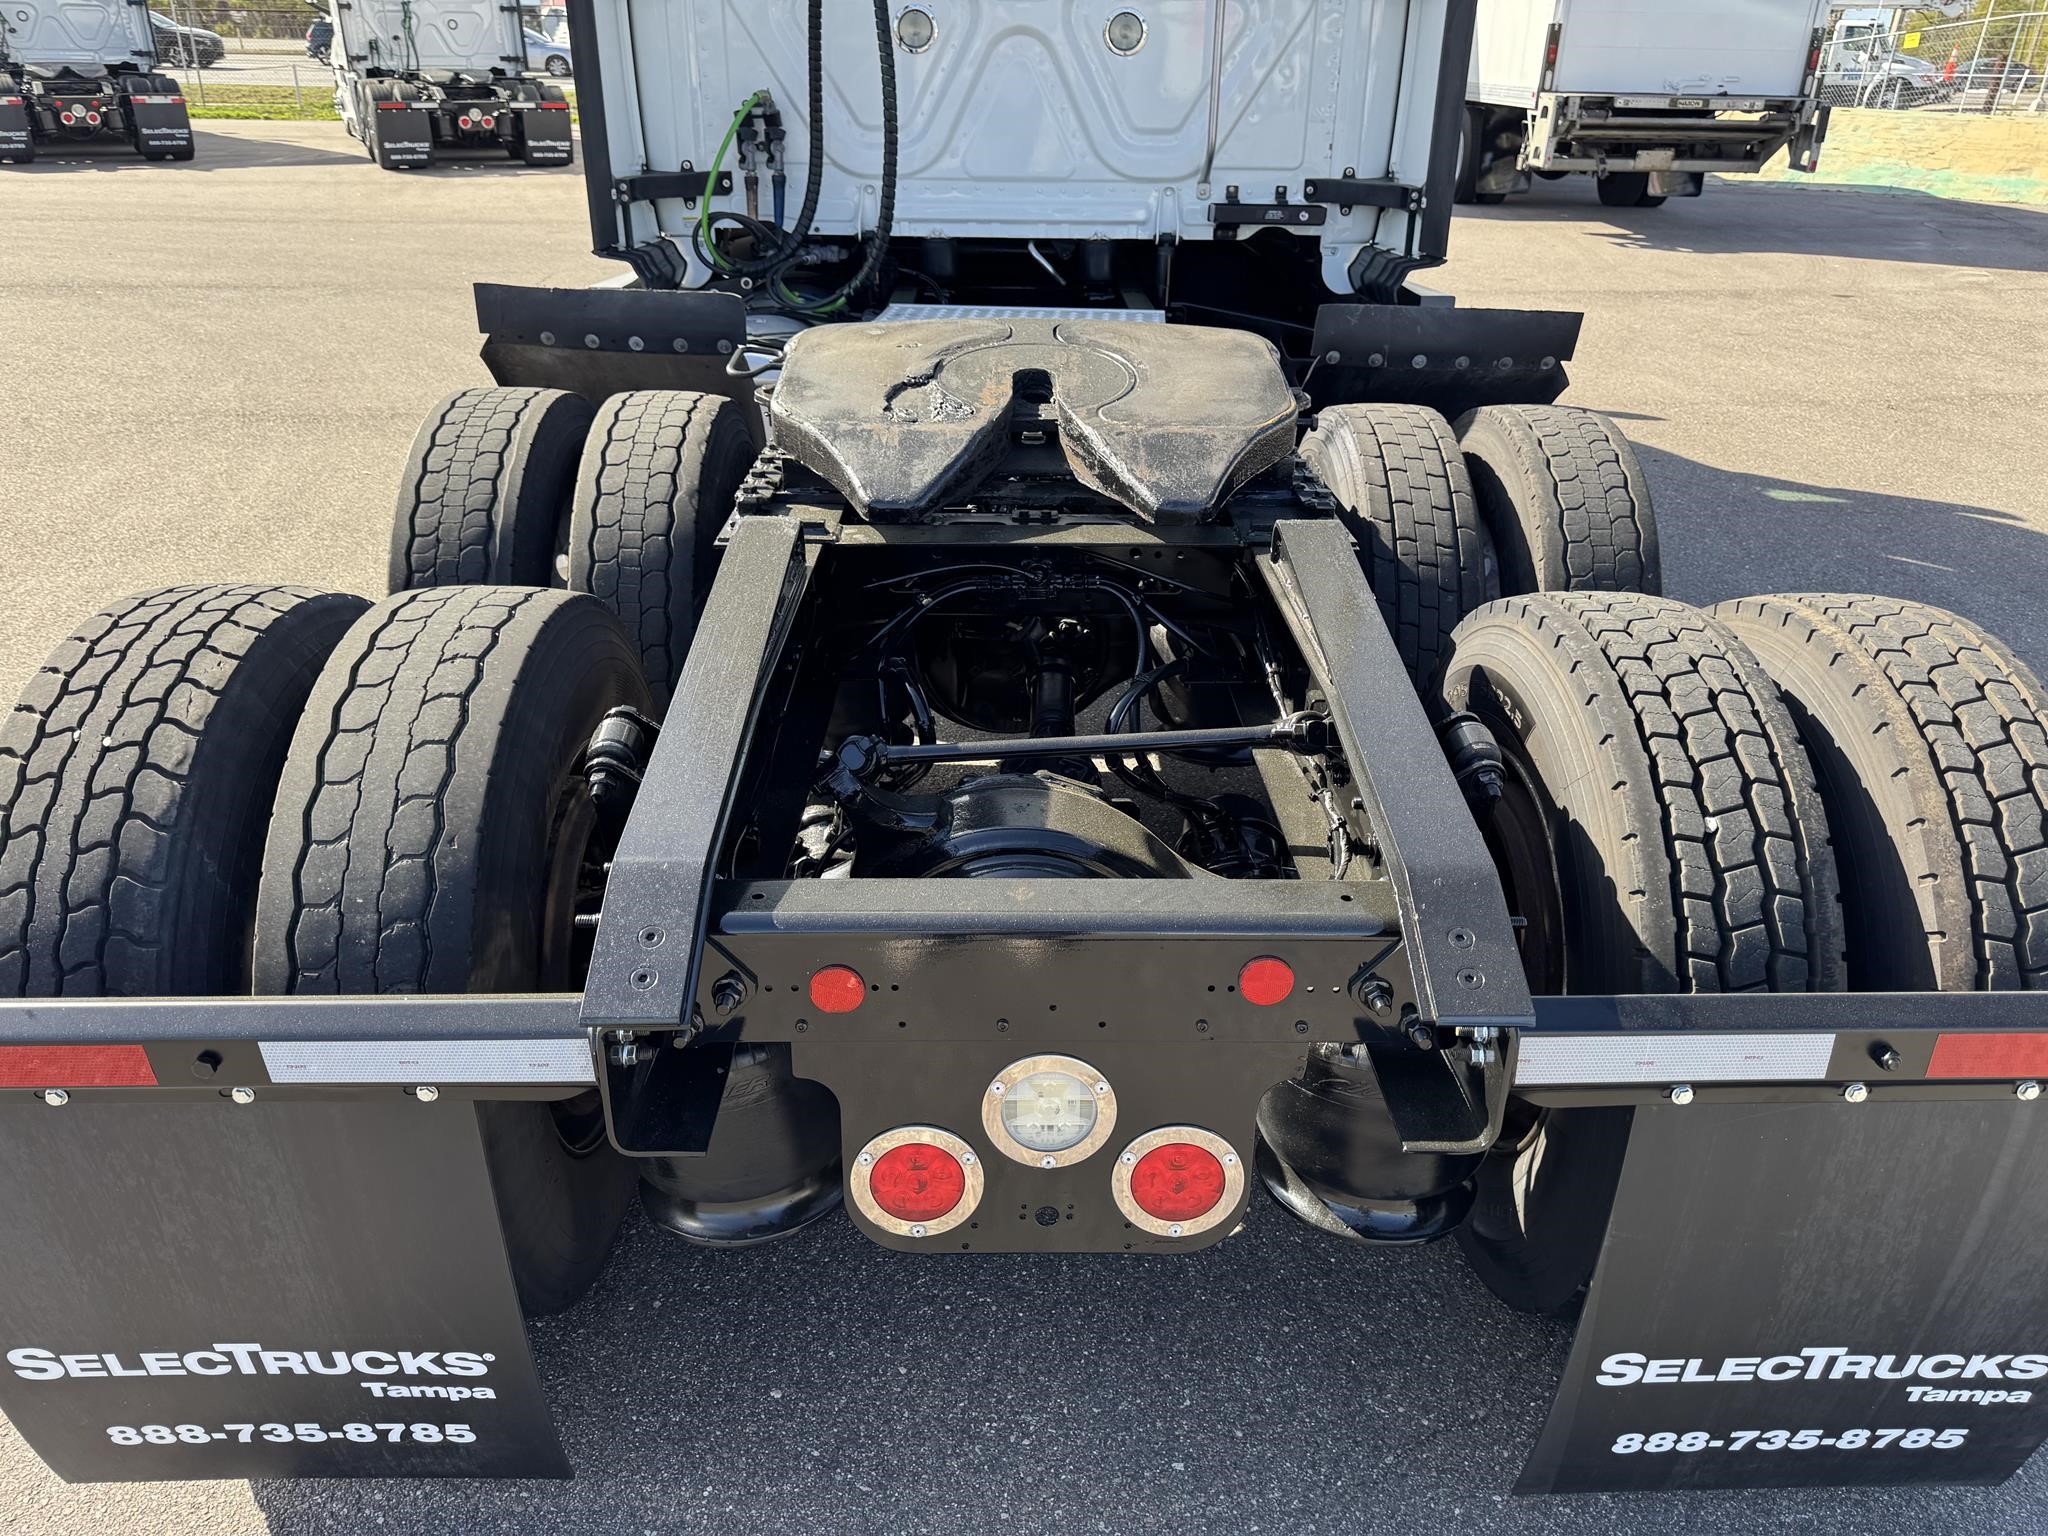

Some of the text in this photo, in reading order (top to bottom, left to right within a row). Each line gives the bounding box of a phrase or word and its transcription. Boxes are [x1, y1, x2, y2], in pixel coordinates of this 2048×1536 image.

[1595, 1346, 2048, 1386] SELECTRUCKS
[360, 1382, 497, 1402] Tampa
[1905, 1386, 2033, 1406] Tampa
[106, 1422, 477, 1446] 888-735-8785
[1611, 1428, 1970, 1454] 888-735-8785
